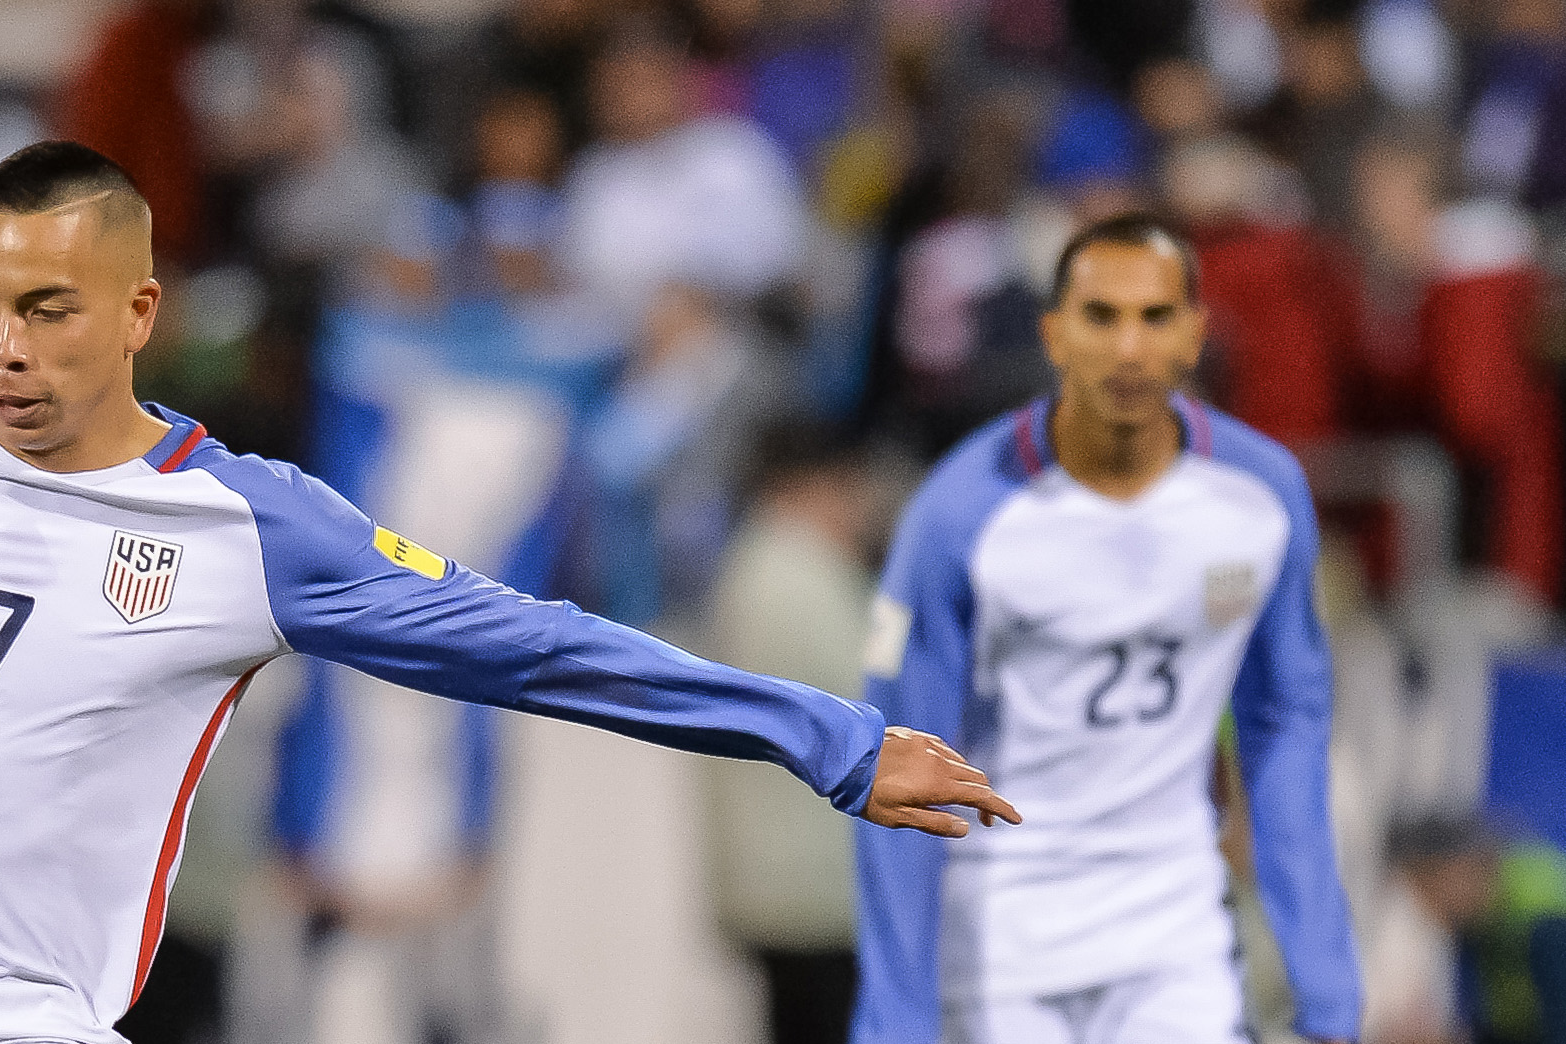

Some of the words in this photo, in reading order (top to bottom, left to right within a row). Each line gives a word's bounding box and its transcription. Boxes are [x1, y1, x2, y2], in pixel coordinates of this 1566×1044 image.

[117, 536, 176, 573] USA
[394, 536, 409, 562] FIF
[1085, 638, 1182, 728] 23
